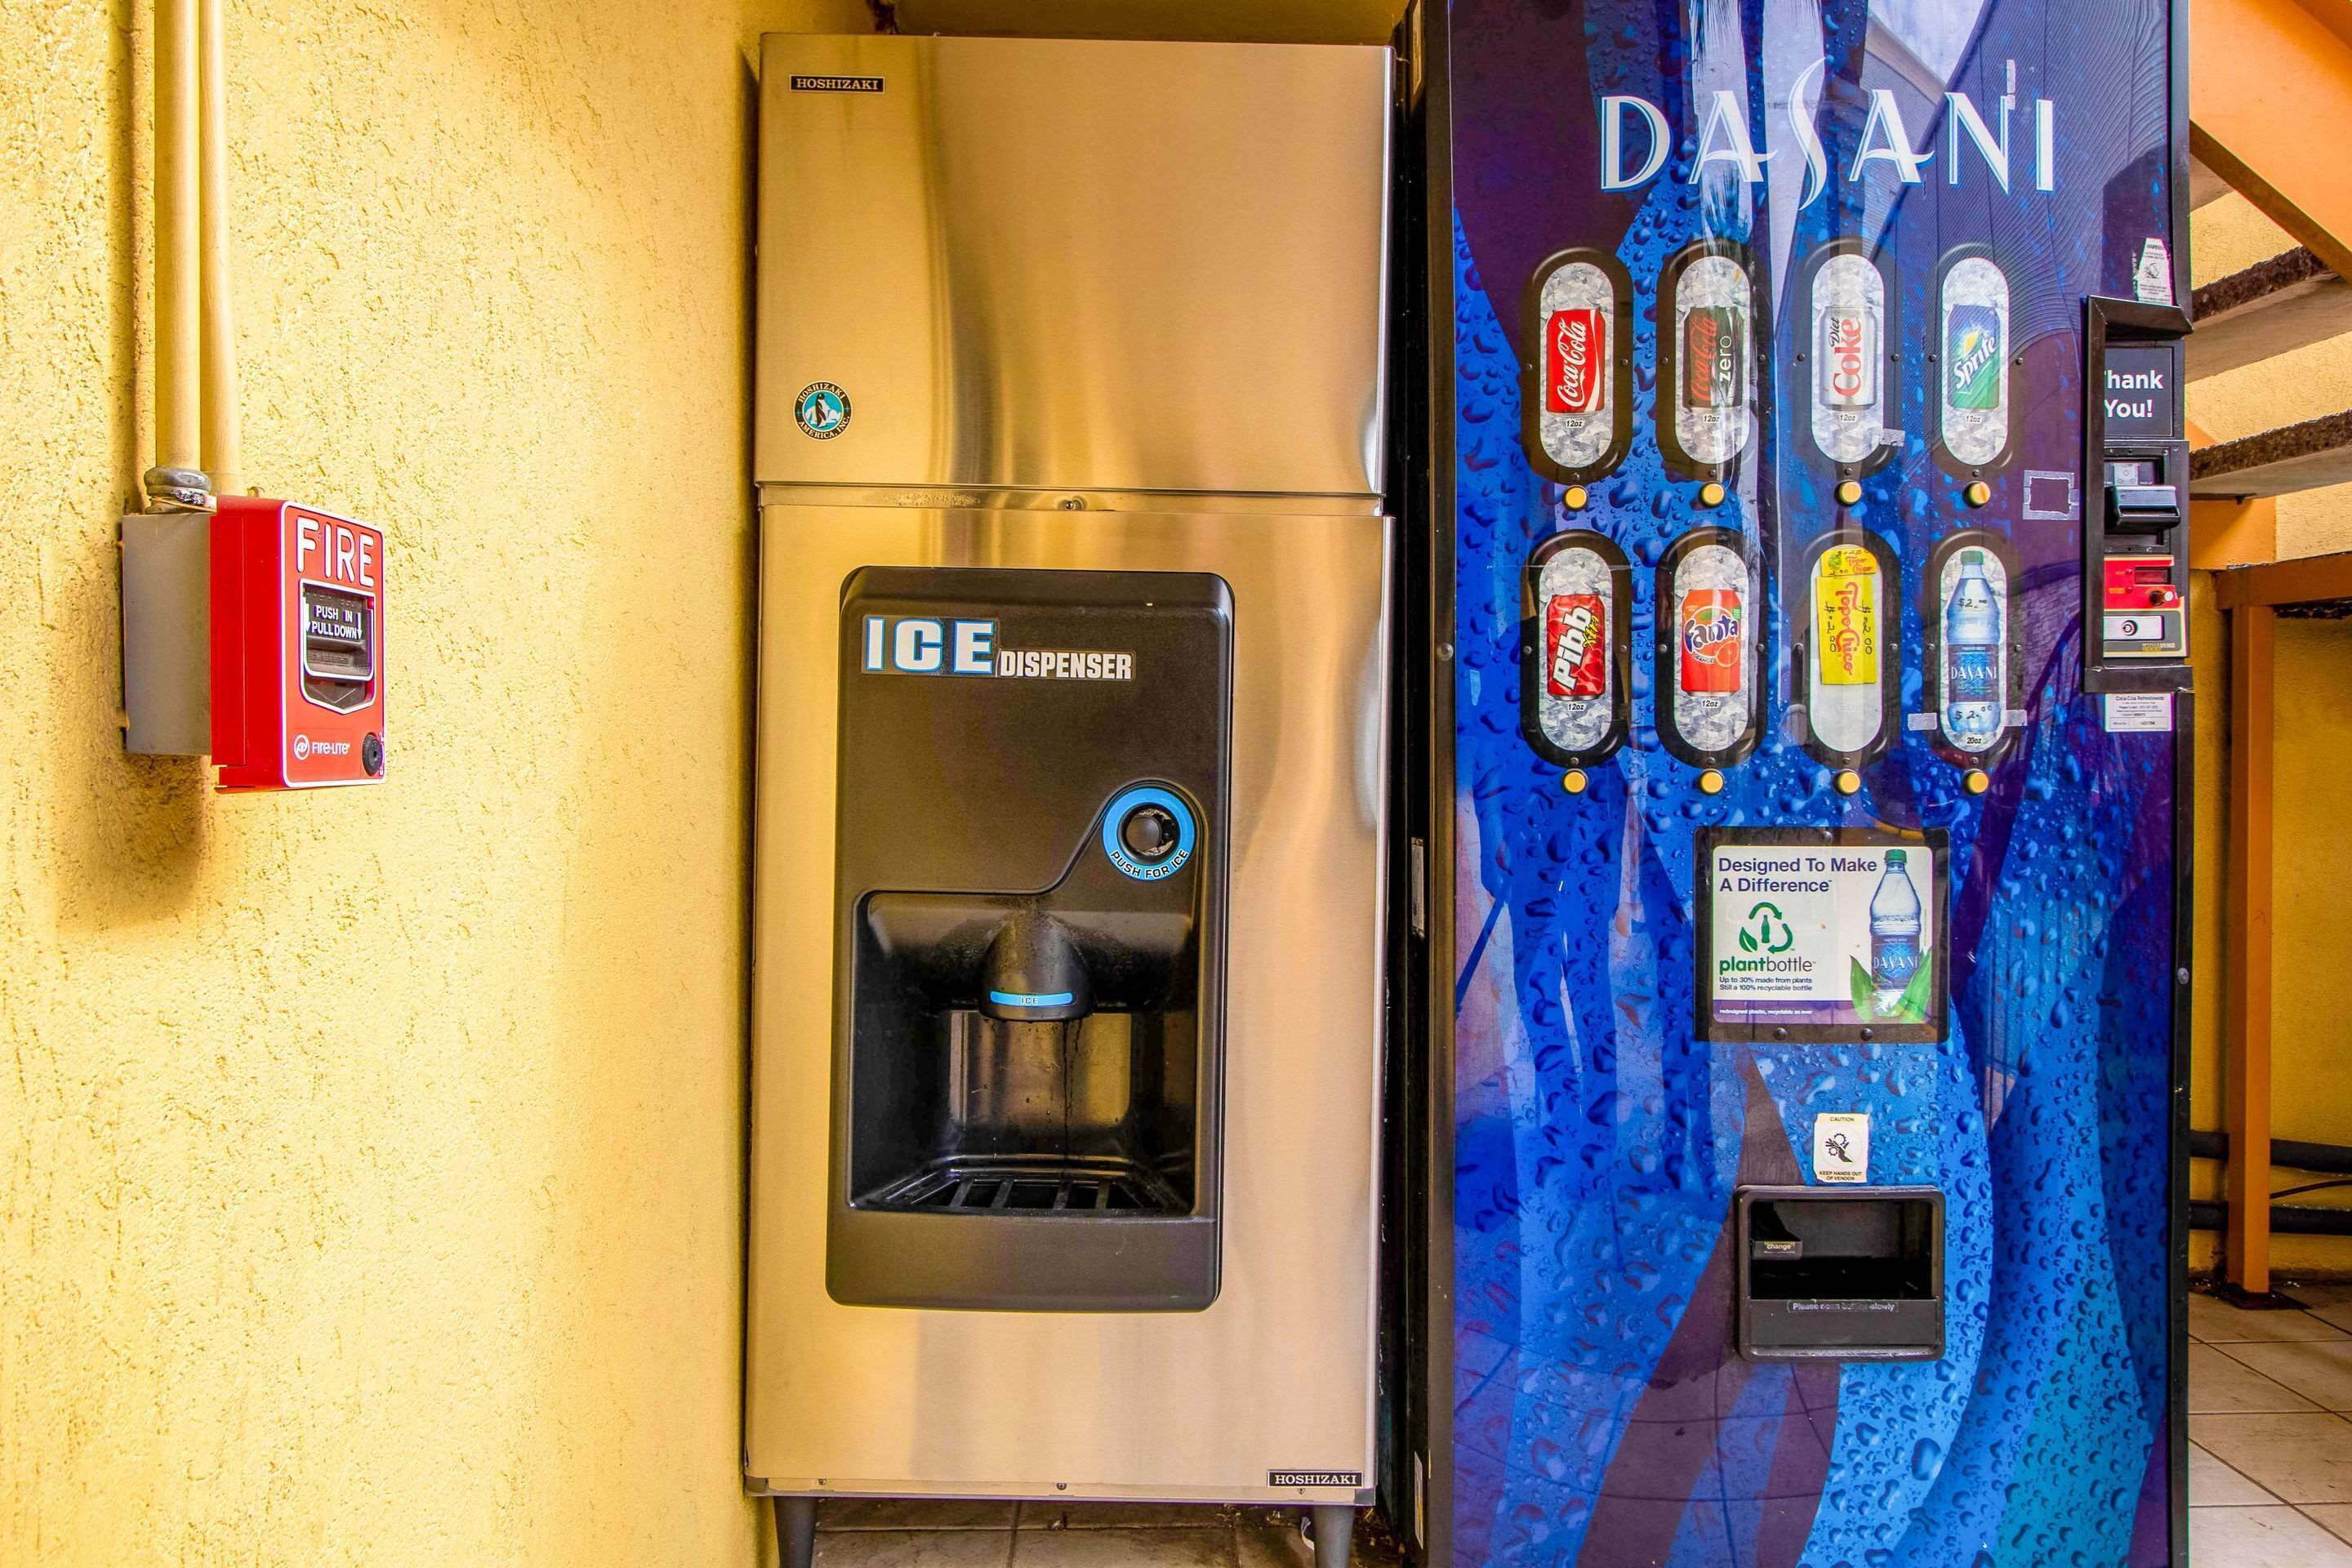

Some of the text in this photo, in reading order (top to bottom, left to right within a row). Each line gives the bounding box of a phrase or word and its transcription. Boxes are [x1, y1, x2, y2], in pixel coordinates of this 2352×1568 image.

[796, 78, 879, 90] HOSHIZAKI
[1601, 56, 2054, 210] DASANI
[1829, 318, 1840, 348] Diet
[1557, 316, 1587, 407] Coca-Cola
[1719, 336, 1732, 382] zero
[1833, 318, 1862, 397] Coke
[1953, 332, 1997, 390] Sprite
[2105, 370, 2163, 390] hank
[798, 383, 846, 403] HOSHIZAKI
[1839, 414, 1856, 422] 12oz
[2104, 399, 2154, 418] You!
[1566, 420, 1583, 428] 12oz
[1966, 415, 1981, 423] 12oz
[296, 515, 374, 588] FIRE
[315, 604, 353, 622] PUSH IN
[1834, 581, 1860, 626] Topo
[311, 621, 357, 639] PULL DOWN
[866, 617, 1133, 680] ICE DISPENSER
[1552, 606, 1593, 691] Pibb
[1835, 628, 1860, 676] Chico
[1951, 663, 1997, 680] DASANI
[1568, 703, 1584, 711] 12oz
[1702, 700, 1718, 708] 12oz
[1111, 849, 1188, 879] PUSH FOR ICE
[1718, 858, 1878, 875] Designed To Make
[1719, 878, 1733, 892] A
[1719, 956, 1812, 975] plantbottle
[1757, 984, 1791, 992] recyclable
[1275, 1475, 1357, 1485] HOSHIZAKI
